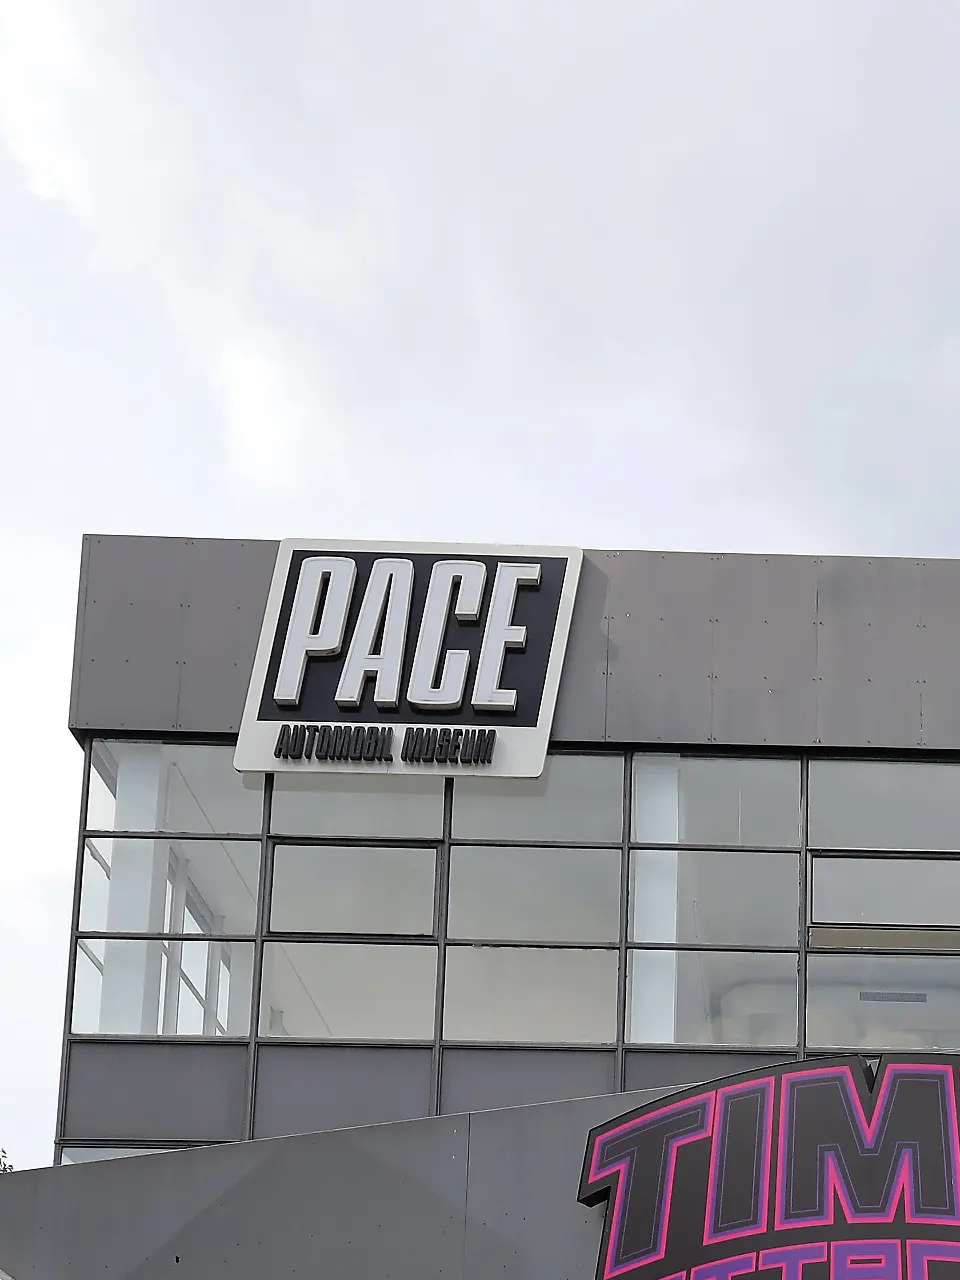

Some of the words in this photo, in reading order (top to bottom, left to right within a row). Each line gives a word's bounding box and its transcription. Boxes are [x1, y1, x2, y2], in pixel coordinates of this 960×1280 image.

[273, 556, 542, 711] PACE
[273, 724, 394, 762] AUTOMOBIL
[401, 727, 498, 764] MUSEUM
